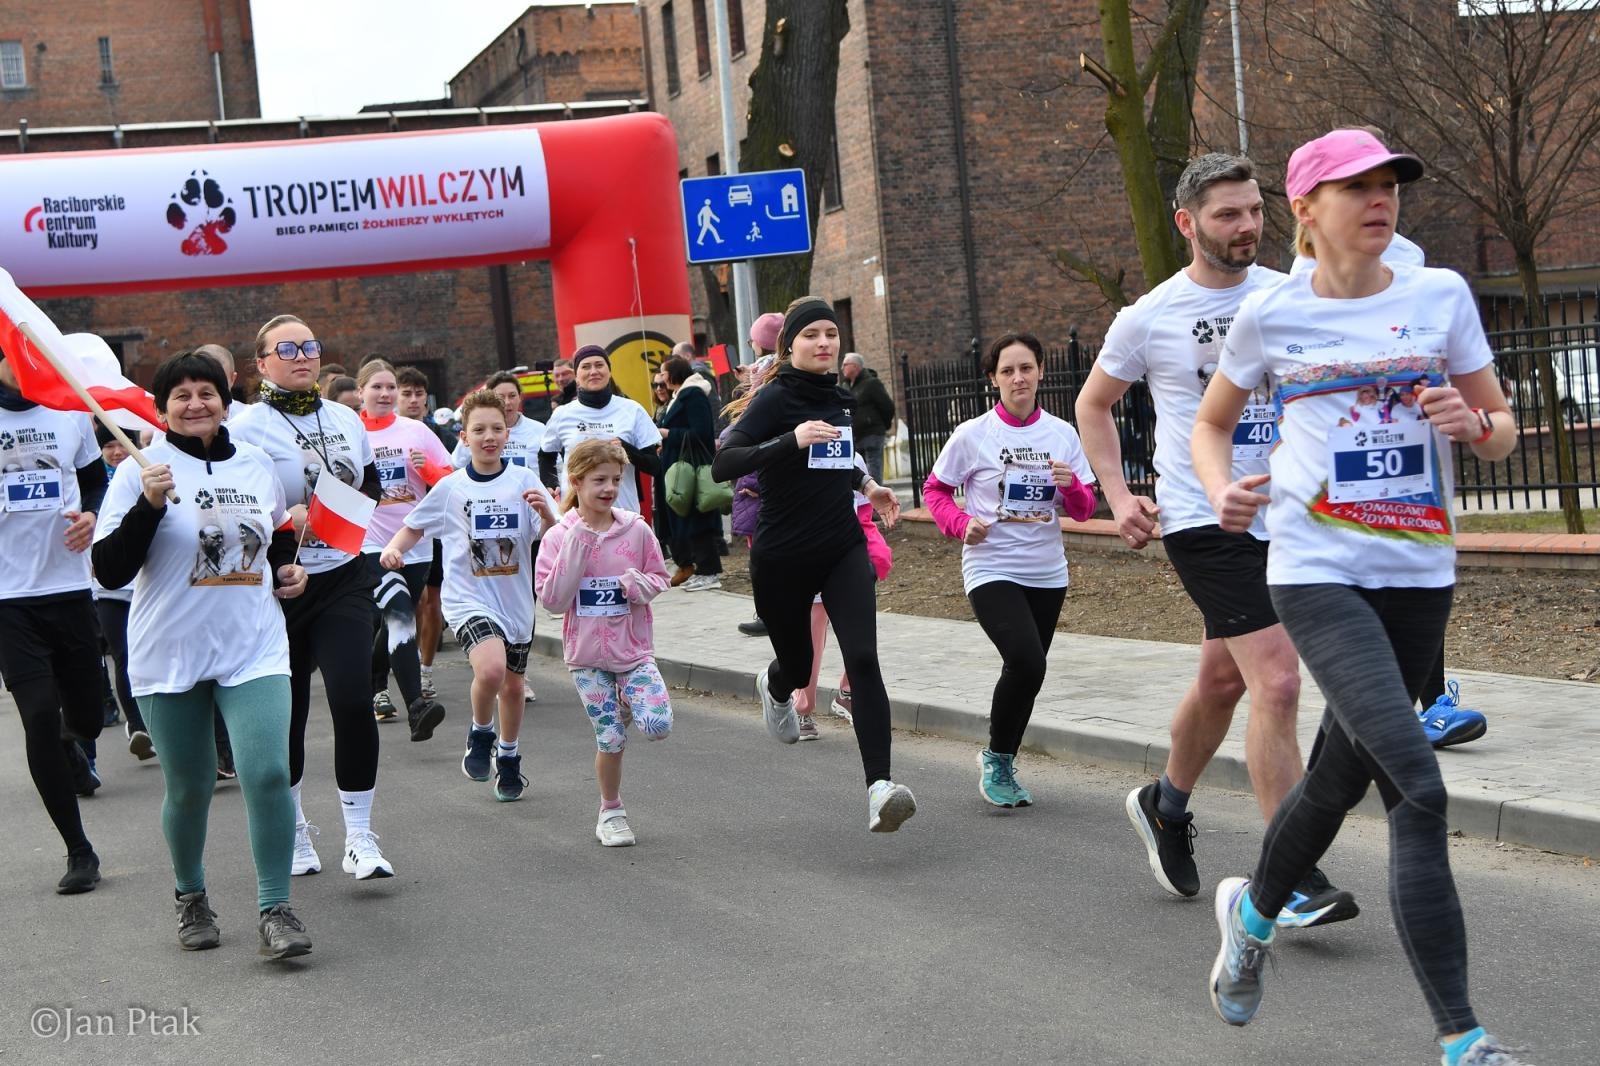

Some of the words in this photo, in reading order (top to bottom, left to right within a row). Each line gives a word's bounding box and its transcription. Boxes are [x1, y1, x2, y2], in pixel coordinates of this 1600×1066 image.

[43, 195, 125, 213] Raciborskie
[276, 225, 306, 236] BIEG
[309, 221, 359, 233] PAMIĘCI
[362, 215, 430, 231] ŻOŁNIERZY
[432, 208, 504, 223] WYKLĘTYCH
[47, 232, 98, 250] Kultury
[17, 432, 56, 444] WILCZYM
[1247, 423, 1273, 443] 40
[1371, 433, 1405, 445] WILCZYM
[375, 448, 403, 459] WILCZYM
[826, 441, 842, 457] 58
[1014, 452, 1051, 461] WILCZYM
[1366, 449, 1403, 478] 50
[380, 468, 395, 480] 37
[24, 483, 47, 499] 74
[1023, 486, 1044, 500] 35
[216, 494, 259, 505] WILCZYM
[1353, 501, 1427, 517] POMAGAMY
[489, 514, 508, 529] 23
[595, 590, 616, 605] 22
